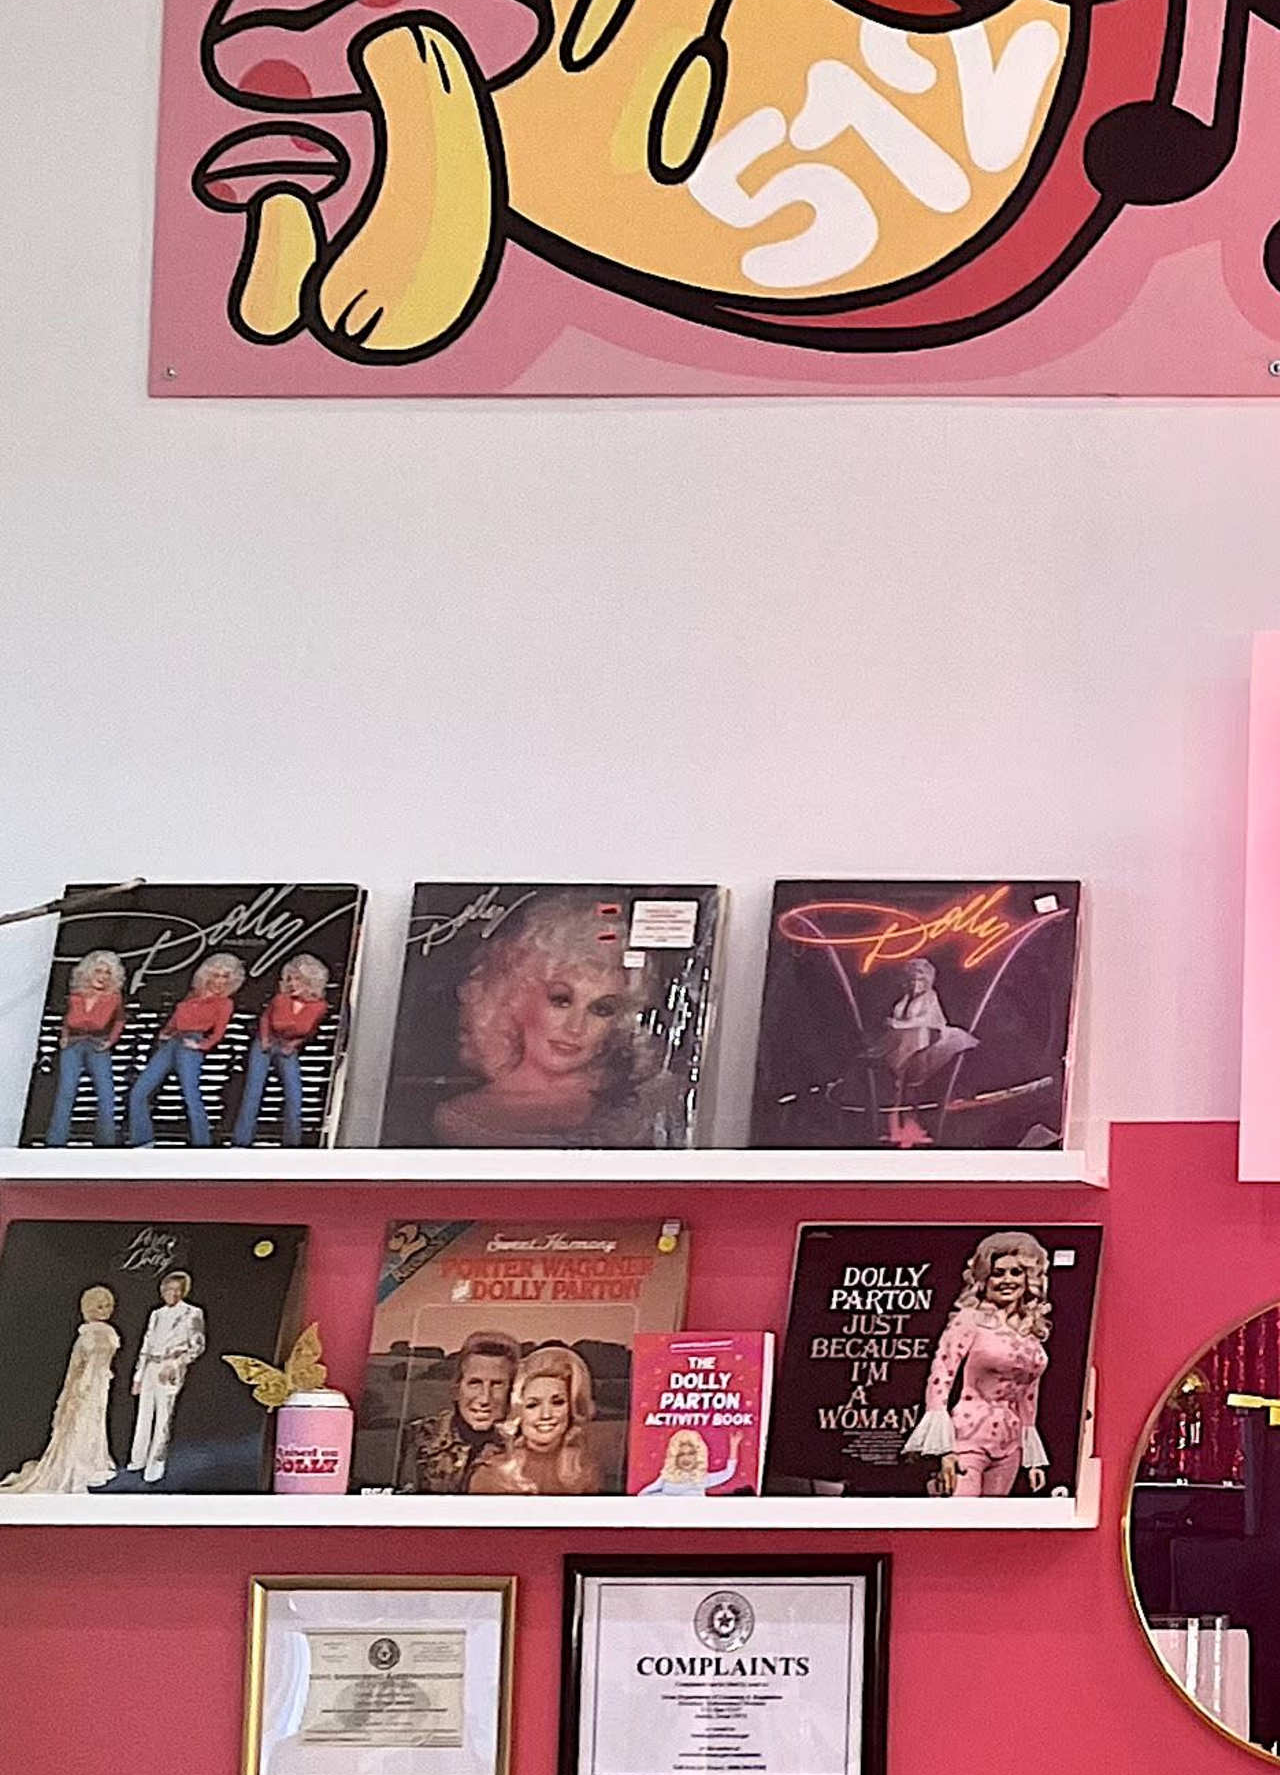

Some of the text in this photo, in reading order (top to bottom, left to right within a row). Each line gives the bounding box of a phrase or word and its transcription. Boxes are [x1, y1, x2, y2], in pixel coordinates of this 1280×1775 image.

[54, 883, 358, 995] Dolly
[778, 884, 1070, 974] Dolly
[843, 1263, 932, 1287] DOLLY
[471, 1279, 547, 1301] DOLLY
[829, 1289, 933, 1314] PARTON
[842, 1314, 911, 1336] JUST
[810, 1337, 931, 1360] BECAUSE
[688, 1356, 717, 1370] THE
[852, 1361, 889, 1387] I'M
[669, 1372, 732, 1390] DOLLY
[659, 1392, 741, 1410] PARTON
[847, 1384, 869, 1409] A
[644, 1412, 753, 1426] ACTIVITY BOOK
[817, 1404, 922, 1431] WOMAN
[636, 1656, 810, 1677] COMPLAINTS
